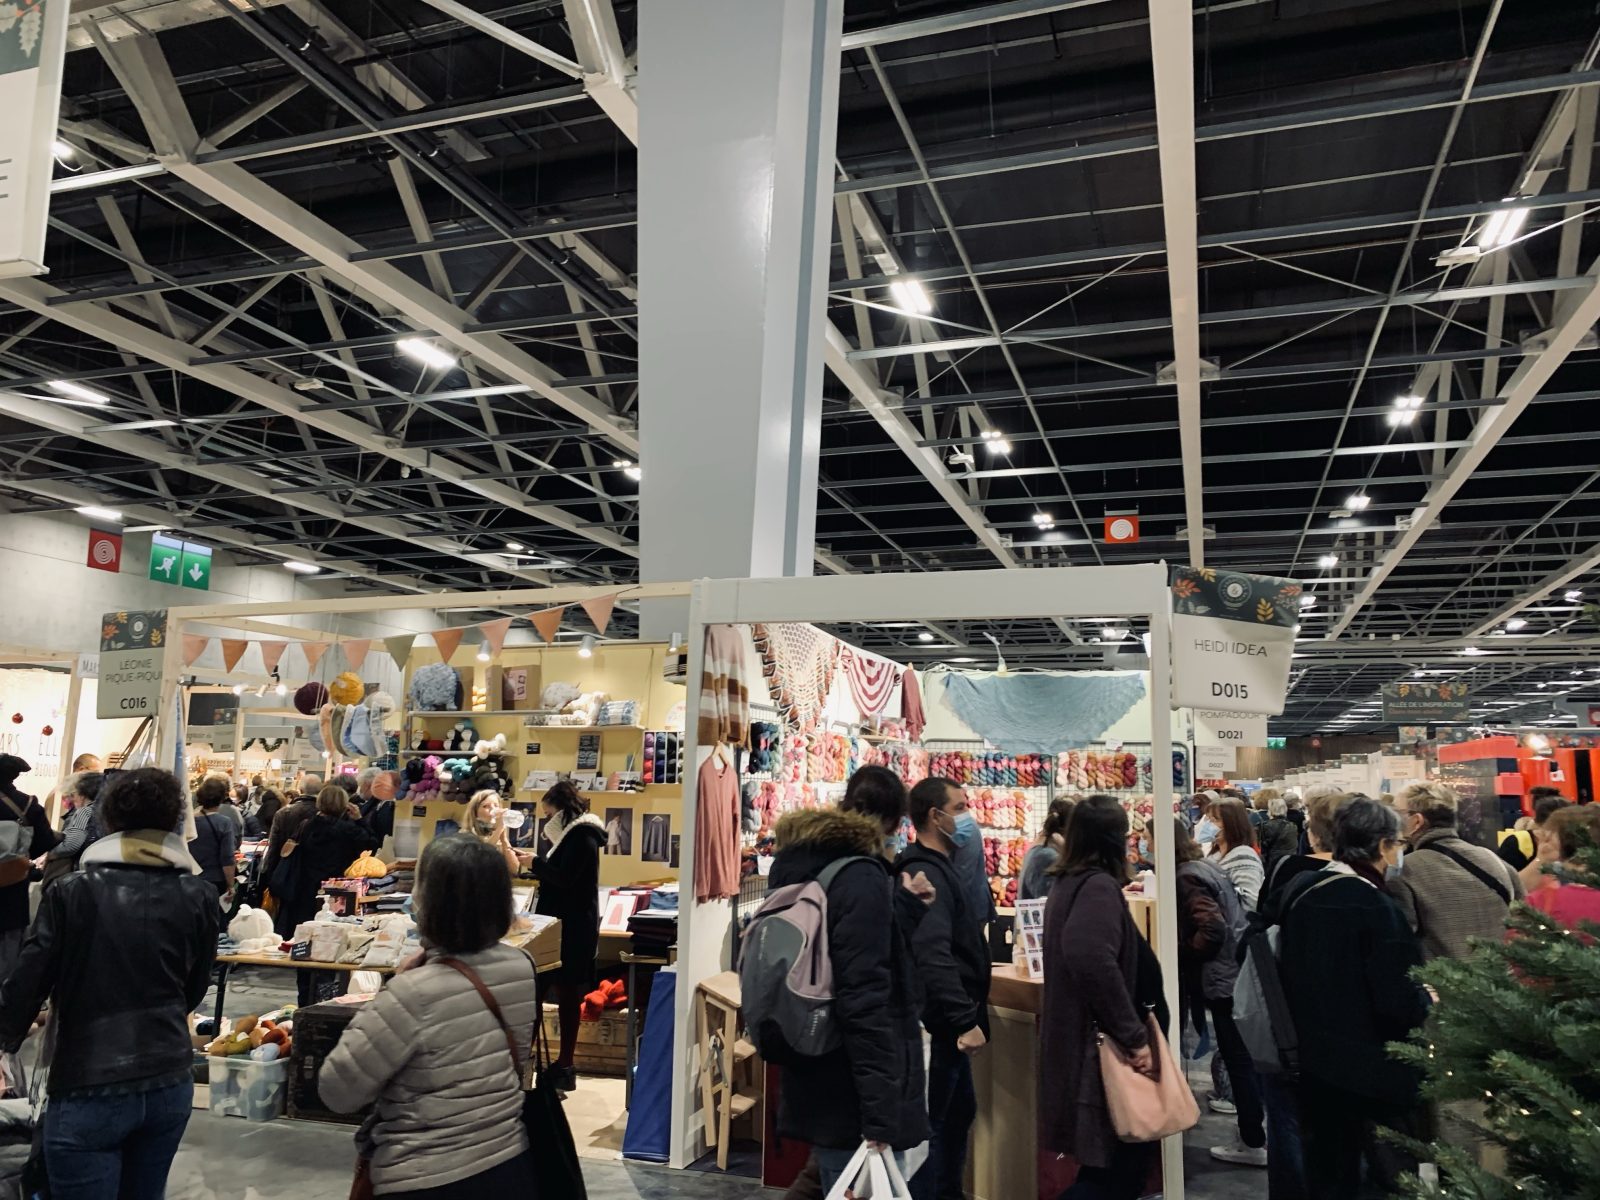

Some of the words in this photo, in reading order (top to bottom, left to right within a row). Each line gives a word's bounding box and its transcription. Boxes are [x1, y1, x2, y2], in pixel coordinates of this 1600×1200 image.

[1194, 639, 1228, 653] HEIDI
[1231, 641, 1268, 657] IDEA
[105, 671, 162, 685] PIQUE-PIQU
[1212, 682, 1249, 699] D015
[120, 697, 147, 709] C016
[1218, 730, 1243, 739] D021
